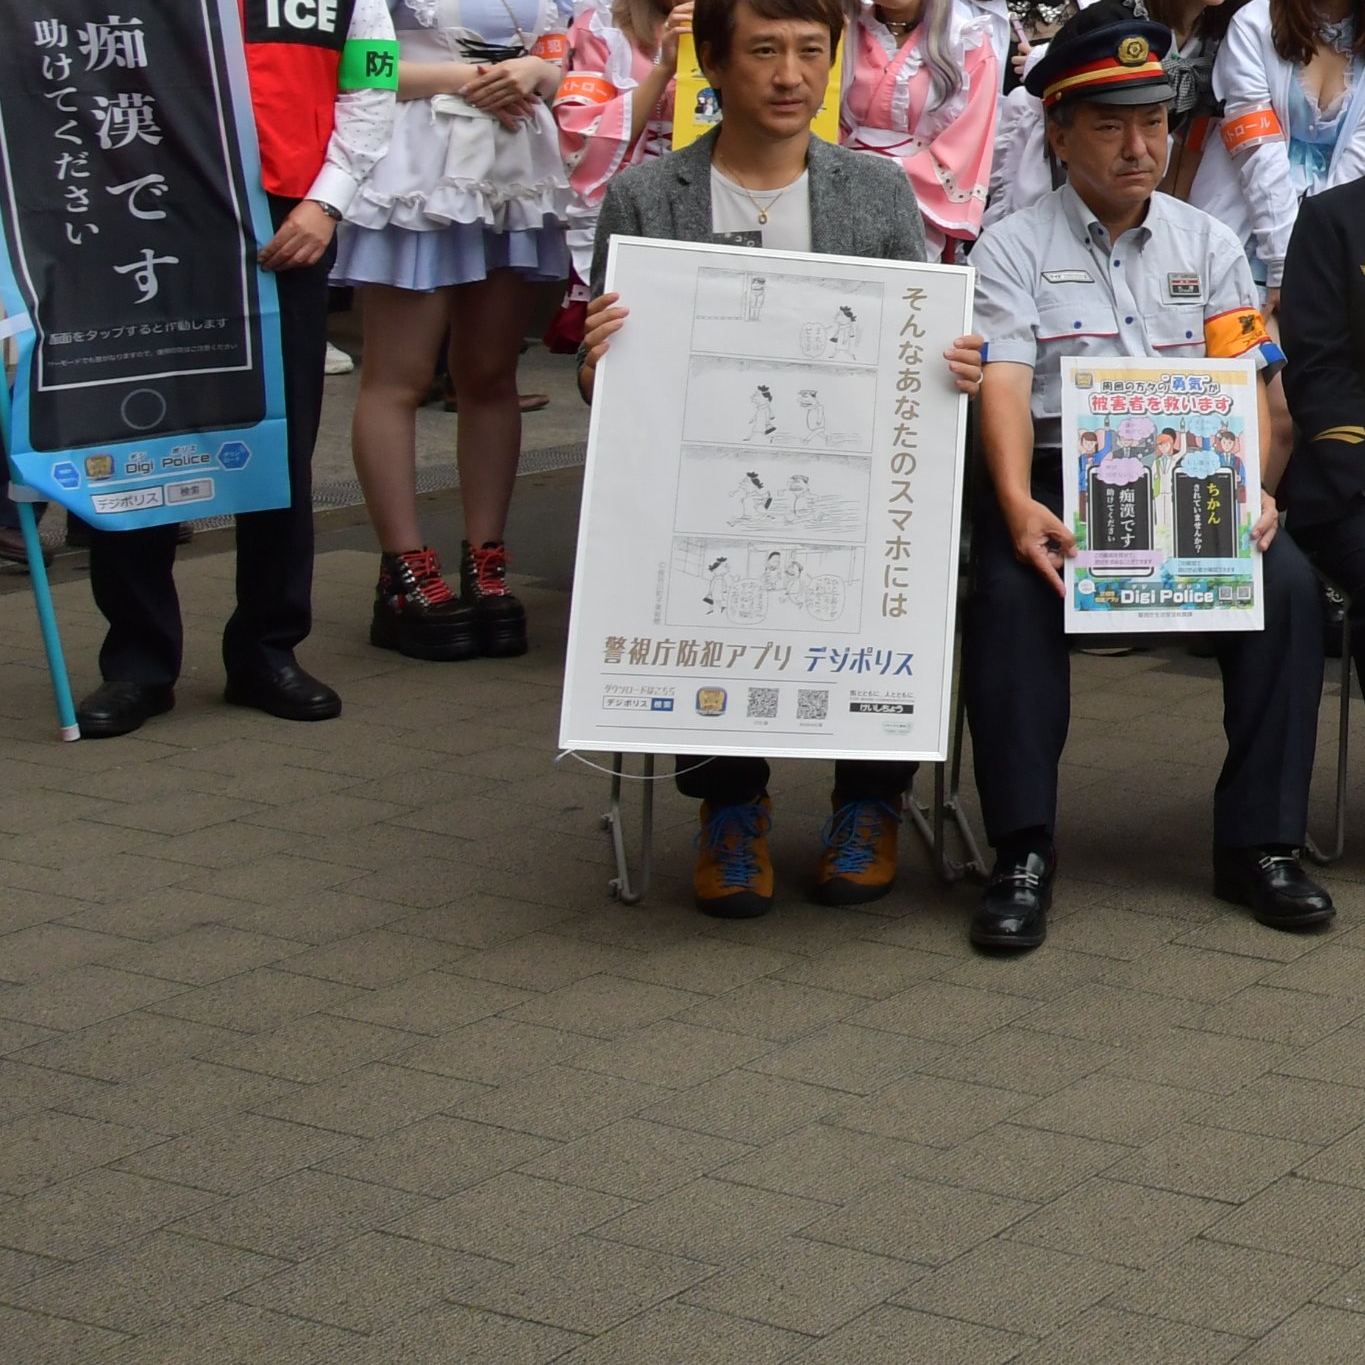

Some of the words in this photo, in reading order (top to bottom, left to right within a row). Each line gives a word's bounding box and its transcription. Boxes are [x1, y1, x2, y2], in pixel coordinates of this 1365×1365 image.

[366, 51, 394, 77] 防
[34, 18, 99, 245] 助けてください
[76, 15, 180, 304] 痴漢です
[1091, 394, 1231, 413] 被害者を救います
[126, 460, 154, 475] Digi
[162, 453, 211, 469] Police
[881, 287, 928, 619] そんなあなたのスマホには
[97, 491, 160, 509] デジポリス
[1106, 488, 1116, 542] 助けてください
[1119, 488, 1136, 548] 痴漢です
[1193, 484, 1202, 554] されていませんか?
[1206, 482, 1221, 525] ちかん
[1121, 589, 1155, 605] Digi
[1160, 589, 1214, 604] Police
[602, 636, 792, 671] 警視庁防犯アプリ
[804, 646, 915, 676] デジポリス
[606, 698, 649, 709] デジポリス
